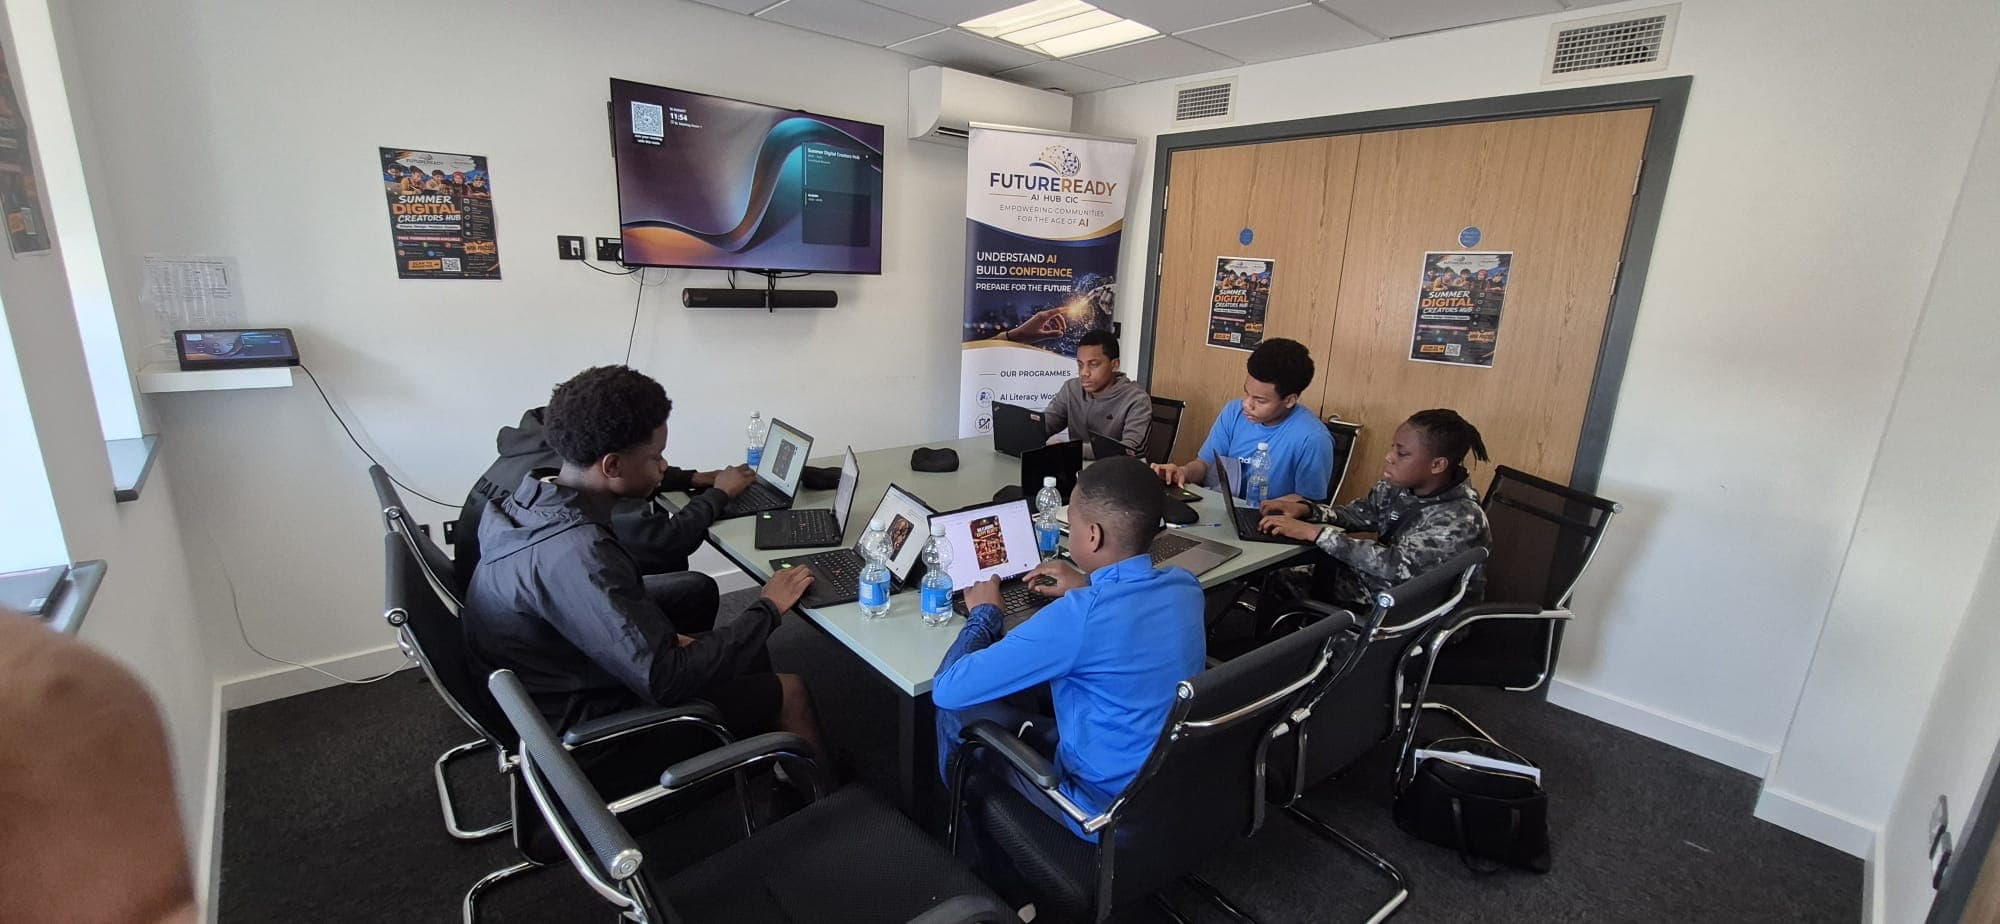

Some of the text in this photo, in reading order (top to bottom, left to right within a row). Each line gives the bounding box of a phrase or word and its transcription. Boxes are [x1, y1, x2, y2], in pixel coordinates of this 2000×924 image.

[669, 112, 688, 121] 11:54
[990, 172, 1117, 197] FUTUREREADY
[398, 195, 452, 204] SUMMER
[1030, 193, 1079, 204] AI HUB CIC
[392, 203, 461, 214] DIGITAL
[1000, 204, 1105, 217] EMPOWERING COMMUNITIES
[398, 214, 444, 222] CREATORS
[1017, 215, 1033, 223] FOR
[1034, 216, 1049, 224] THE
[1050, 217, 1065, 225] AGE
[1078, 218, 1089, 227] AI
[976, 251, 1058, 264] UNDERSTAND AI
[976, 265, 1073, 278] BUILD CONFIDENCE
[975, 282, 1072, 293] PREPARE FOR THE FUTURE
[1214, 294, 1249, 303] DIGITAL
[1428, 290, 1470, 299] SUMMER
[1421, 298, 1474, 308] DIGITAL
[1000, 370, 1017, 378] OUR
[1000, 393, 1008, 401] AI
[1010, 392, 1039, 402] Literacy
